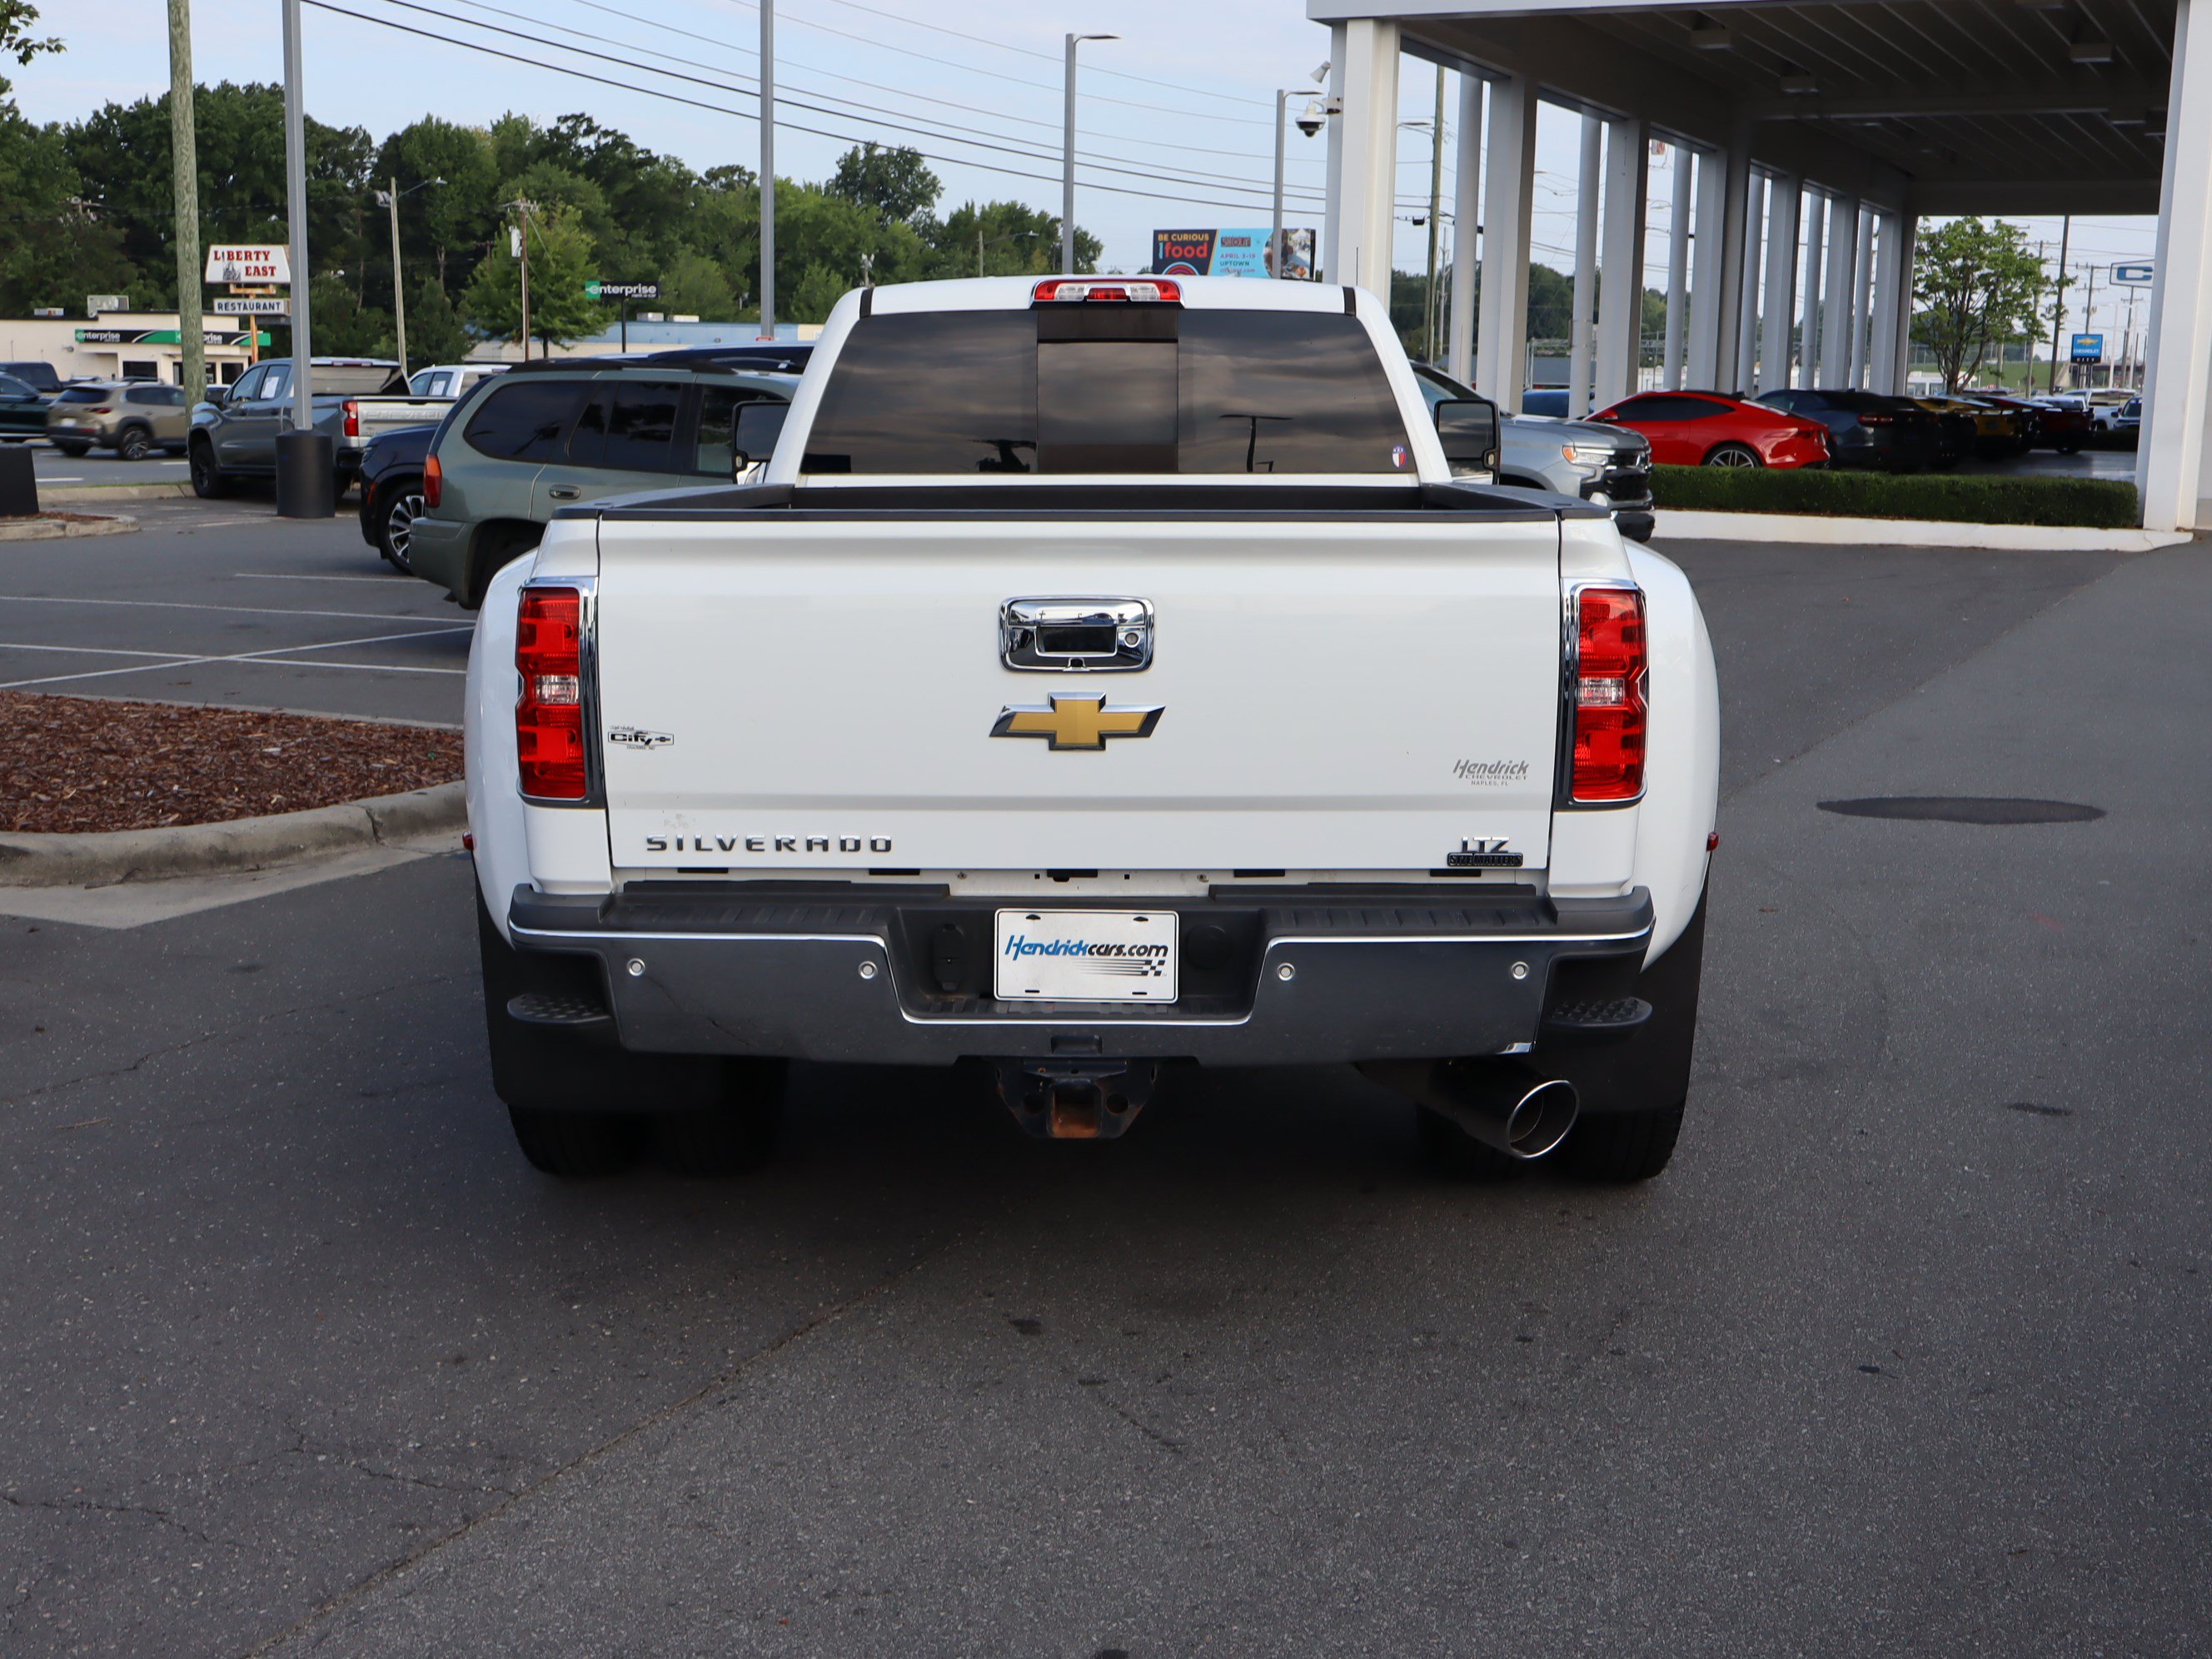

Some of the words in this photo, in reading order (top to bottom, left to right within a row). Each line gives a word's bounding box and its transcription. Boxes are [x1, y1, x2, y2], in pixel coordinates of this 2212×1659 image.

[214, 251, 271, 262] LIBERTY
[1164, 242, 1208, 258] food
[245, 266, 276, 276] EAST
[586, 283, 656, 296] enterprise
[217, 301, 281, 311] RESTAURANT
[76, 331, 121, 341] enterprise
[610, 732, 653, 745] City
[1452, 759, 1529, 779] Hendrick
[646, 834, 892, 853] SILVERADO
[1462, 837, 1510, 853] LTZ
[1004, 934, 1168, 961] Hendrickcars.com
